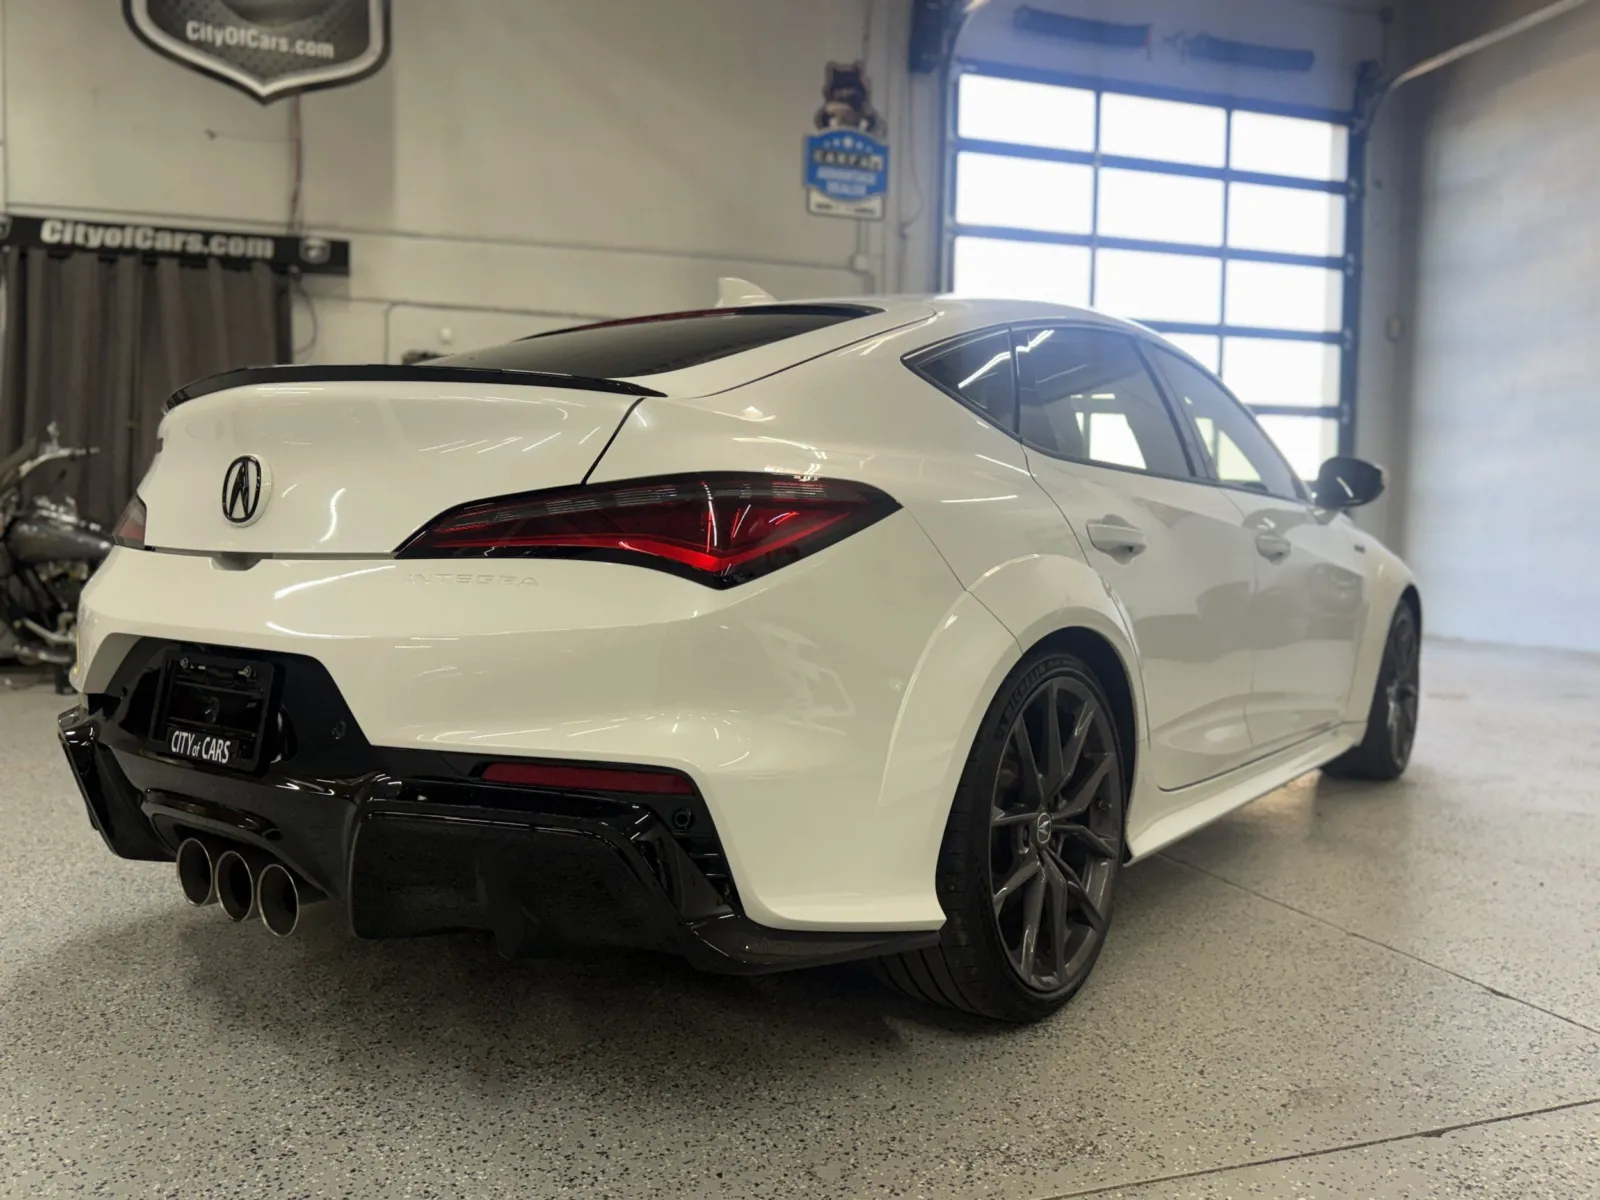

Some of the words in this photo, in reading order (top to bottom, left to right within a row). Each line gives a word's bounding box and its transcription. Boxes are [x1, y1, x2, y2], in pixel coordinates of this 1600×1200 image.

[186, 20, 335, 59] CityOfCars.com
[40, 219, 275, 259] CityofCars.com
[404, 573, 539, 587] INTEGRA
[171, 730, 195, 755] CITY
[191, 741, 201, 757] of
[201, 736, 231, 763] CARS
